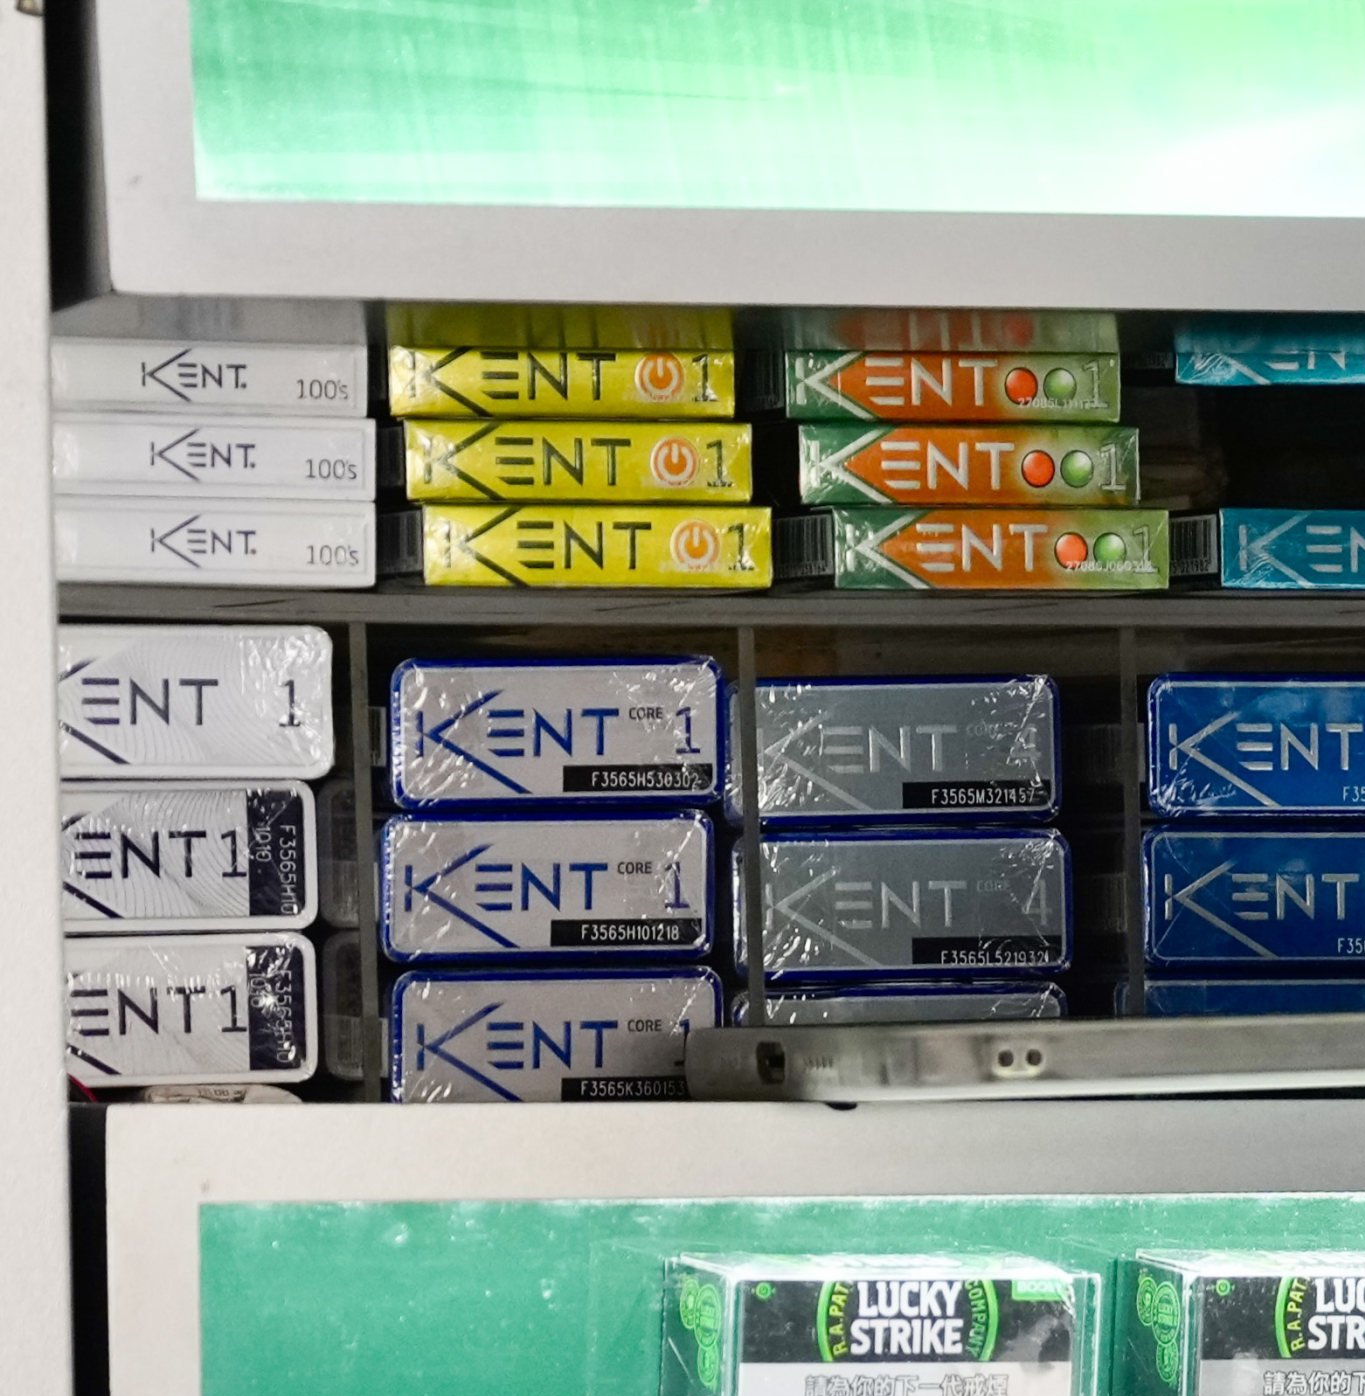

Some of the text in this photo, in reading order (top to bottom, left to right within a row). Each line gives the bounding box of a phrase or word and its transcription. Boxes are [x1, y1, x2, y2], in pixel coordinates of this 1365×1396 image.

[295, 378, 349, 400] 100's
[406, 346, 718, 416] KENT 1
[795, 351, 998, 419] KENT
[305, 459, 358, 480] 100's
[423, 422, 733, 500] KENT 1
[811, 427, 1015, 504] KENT
[306, 544, 359, 567] 100's
[442, 507, 755, 586] KENT 1
[844, 510, 1049, 589] KENT
[416, 689, 702, 794] KENT CORE 1
[757, 711, 957, 810] KENT
[1168, 711, 1363, 808] KENT
[404, 843, 690, 949] KENT CORE 1
[581, 923, 681, 942] F3565H101218
[765, 869, 967, 967] KENT
[1164, 861, 1359, 958] KENT
[416, 1001, 663, 1103] KENT CORE
[850, 1318, 963, 1356] STRIKE
[857, 1280, 963, 1318] LUCKY
